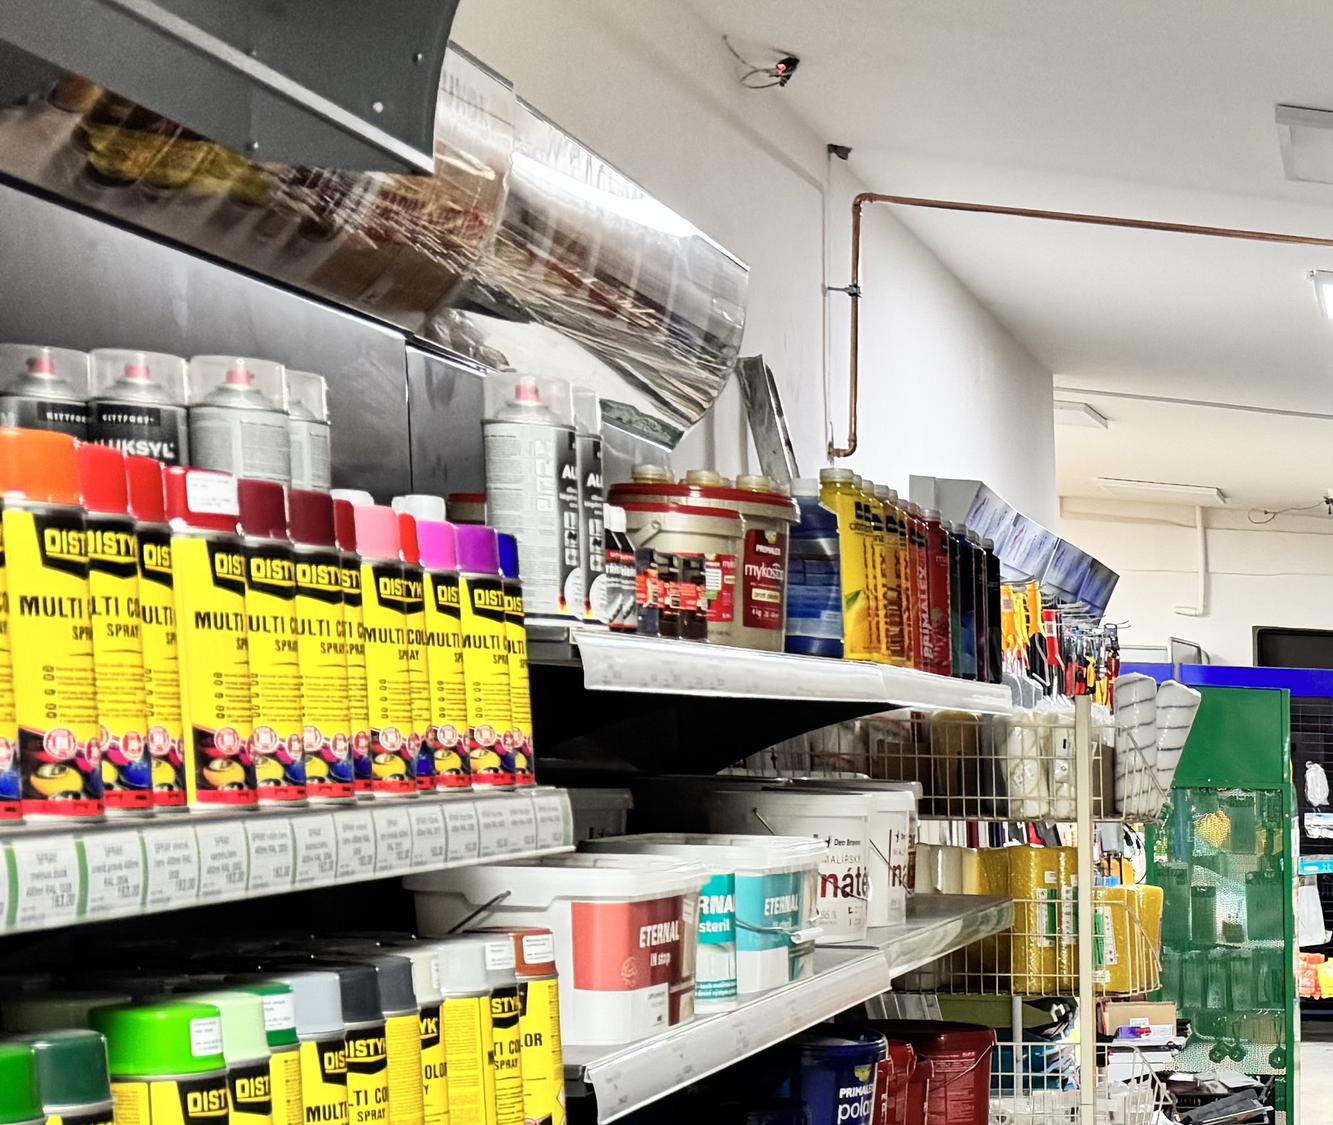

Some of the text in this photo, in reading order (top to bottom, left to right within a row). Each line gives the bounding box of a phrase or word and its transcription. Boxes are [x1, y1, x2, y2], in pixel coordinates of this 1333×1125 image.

[44, 528, 87, 557] DIST
[20, 595, 82, 618] MULTI
[364, 626, 406, 646] MULTI
[820, 867, 868, 898] nátě
[764, 894, 800, 916] ETERNAL
[640, 920, 680, 948] ETERNAL
[187, 1089, 229, 1113] DIST
